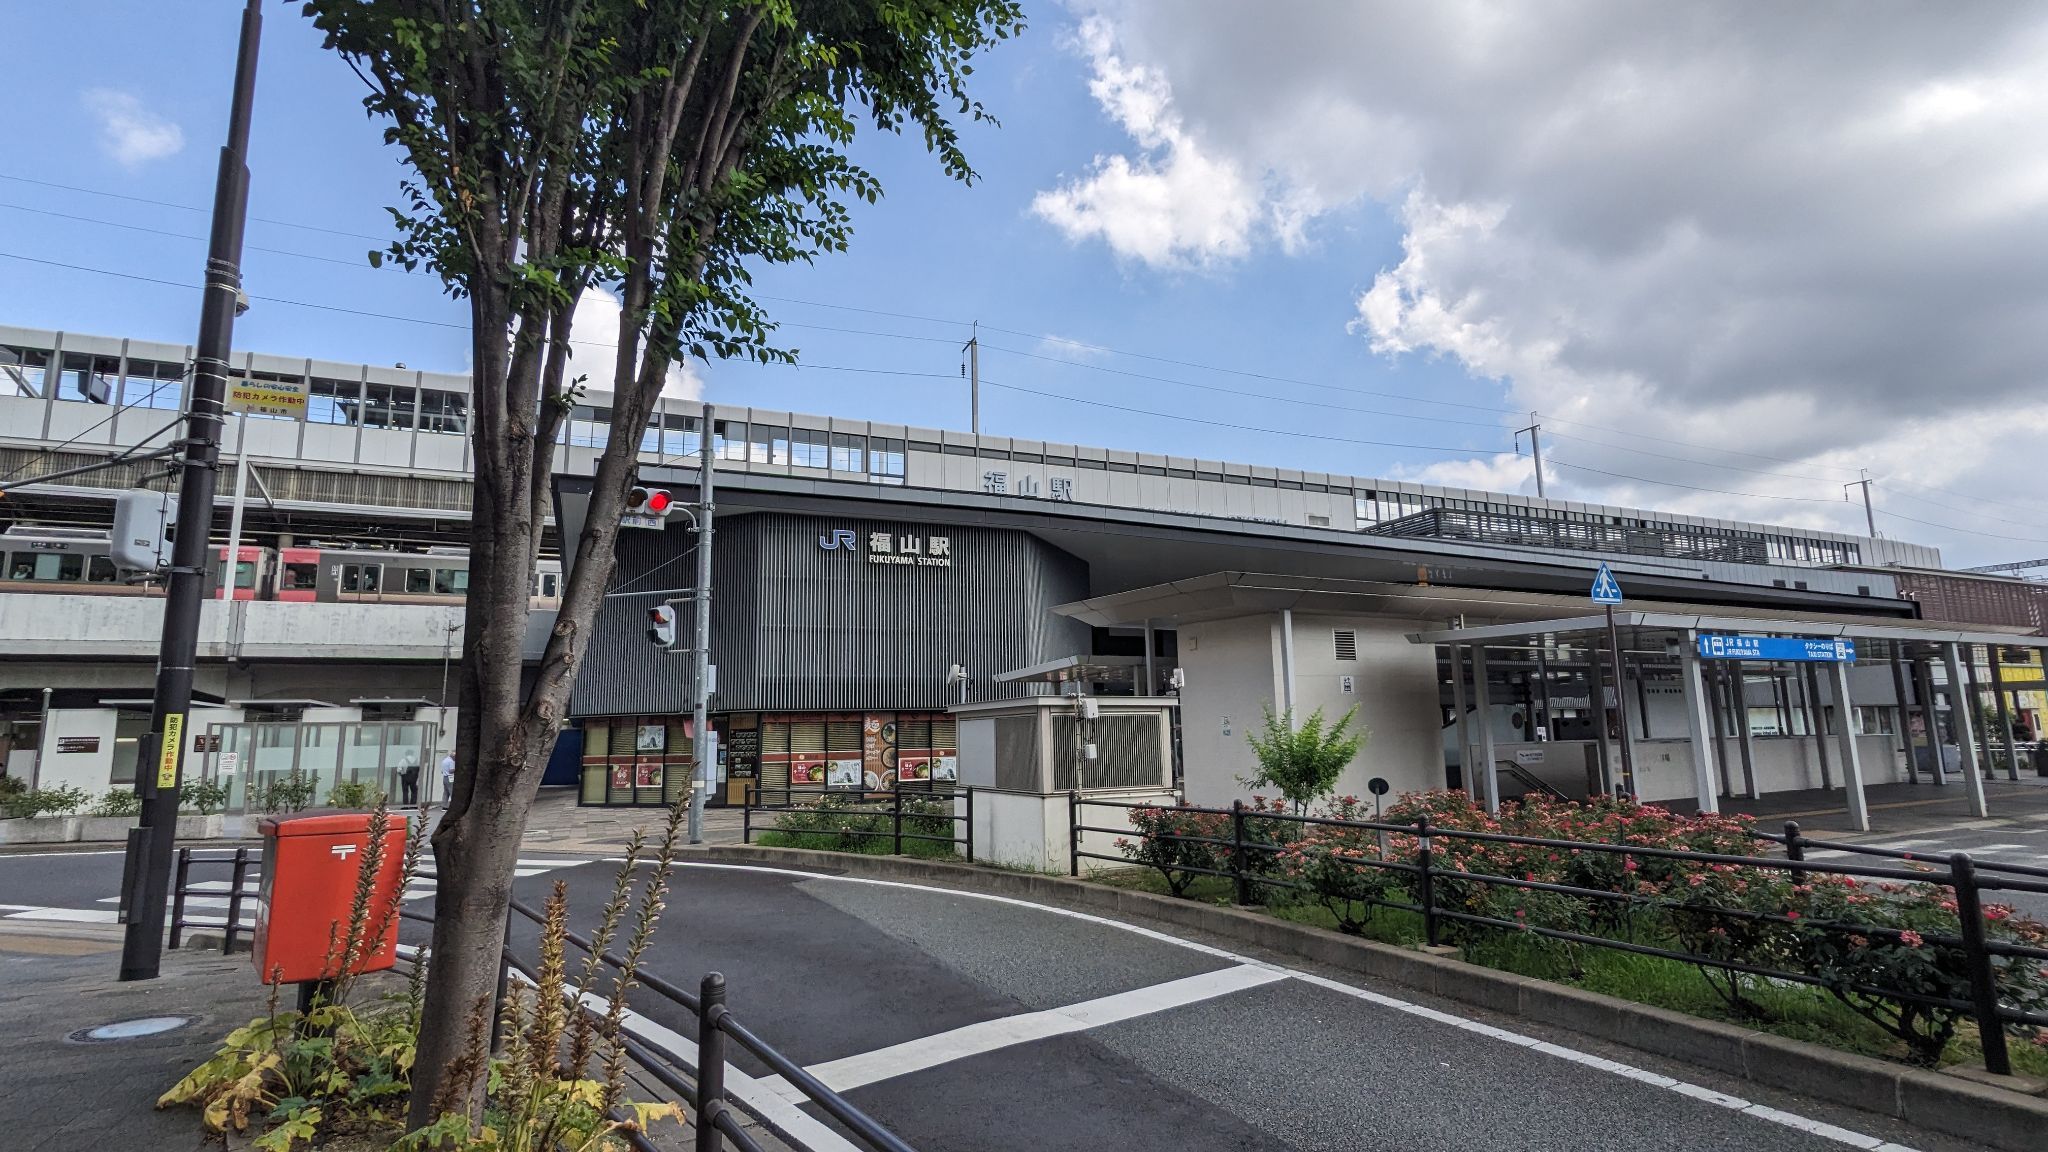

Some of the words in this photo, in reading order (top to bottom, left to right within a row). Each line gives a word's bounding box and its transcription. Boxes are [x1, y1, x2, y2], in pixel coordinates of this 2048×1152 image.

[233, 391, 304, 404] 防犯カメラ作動中
[984, 471, 1073, 501] 福山駅
[820, 529, 856, 551] JR
[869, 532, 950, 555] 福山駅
[869, 554, 914, 565] FUKUYAMA
[917, 557, 950, 567] STATION
[1804, 642, 1834, 651] タクシーのりば
[164, 716, 178, 771] 防犯カメラ作動中
